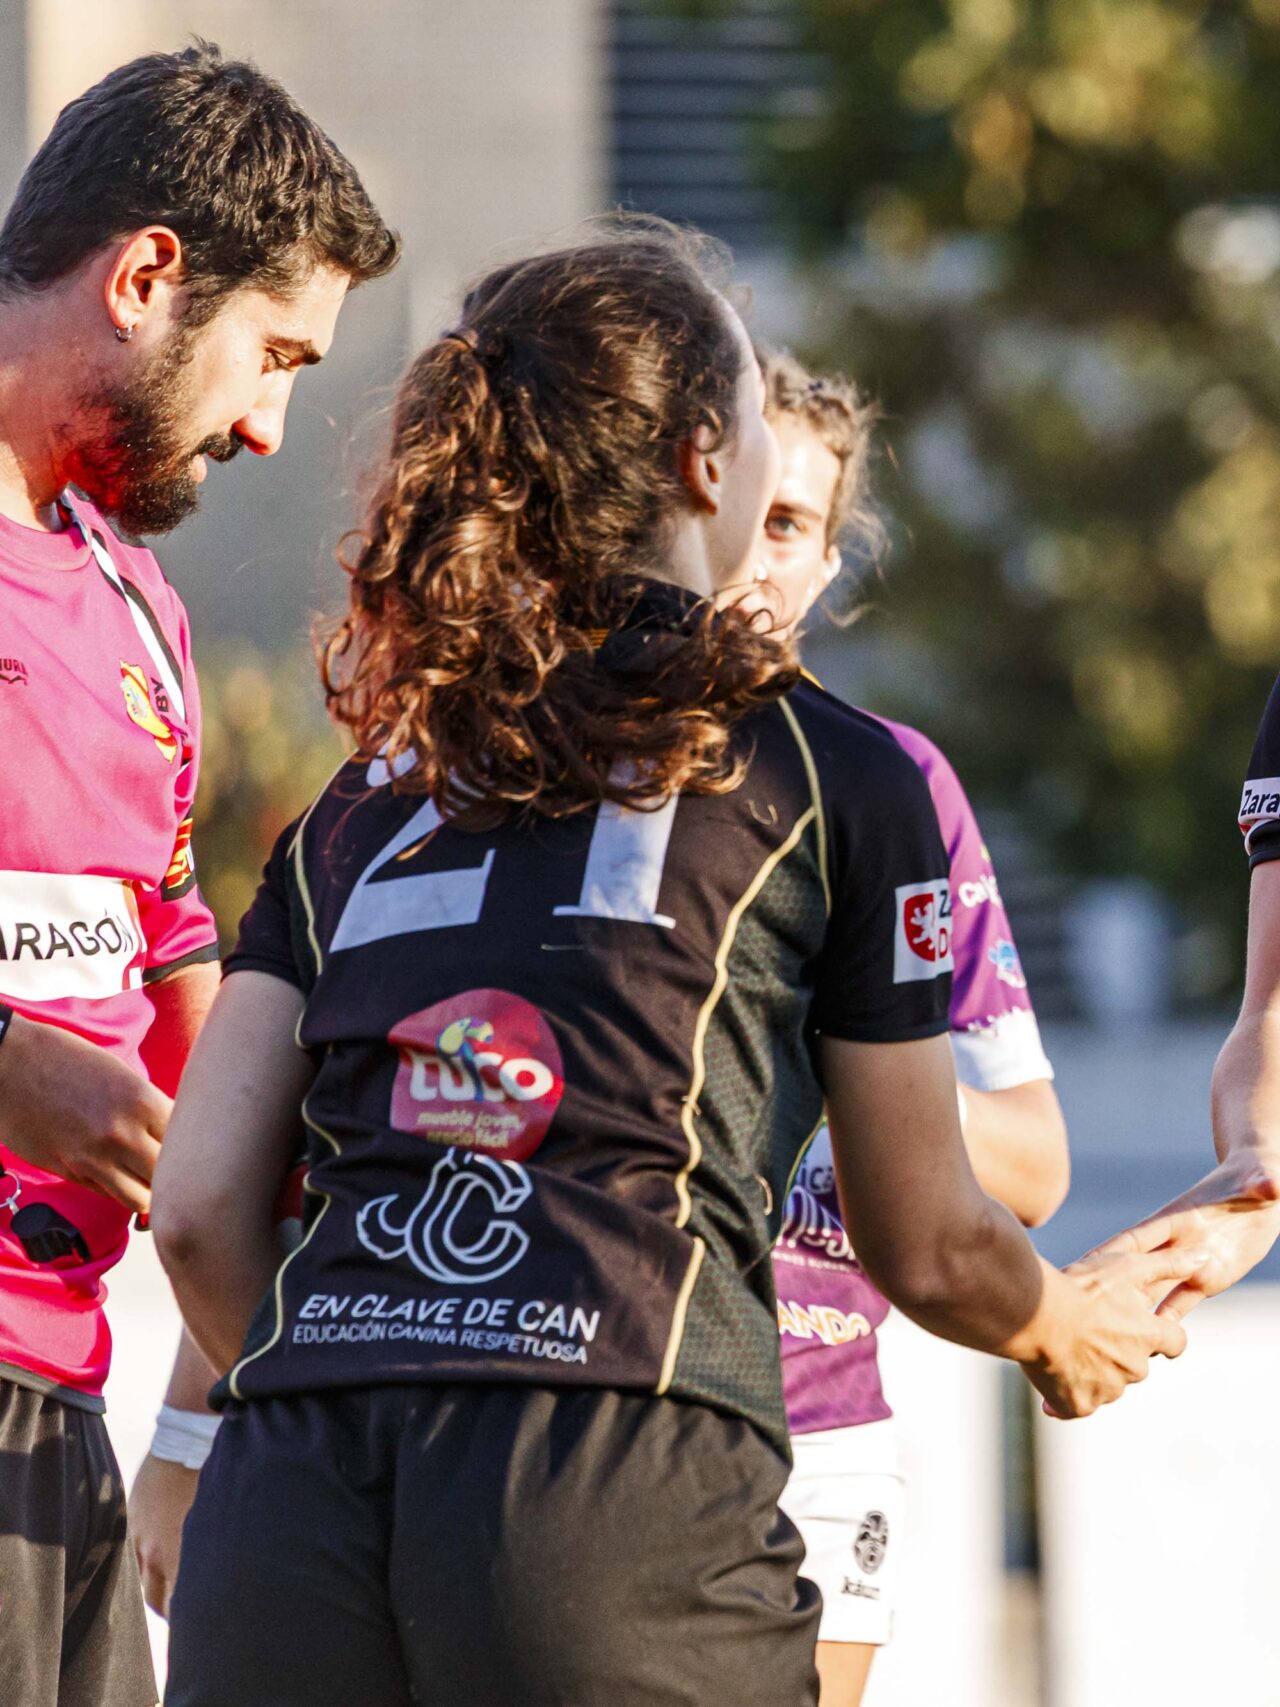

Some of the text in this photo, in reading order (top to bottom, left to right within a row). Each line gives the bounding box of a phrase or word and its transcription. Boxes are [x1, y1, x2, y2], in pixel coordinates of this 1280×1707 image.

[0, 907, 134, 961] RAGÓN
[293, 1318, 588, 1366] EDUCACIÓN CANINA RESPETUOSA
[299, 1293, 600, 1342] EN CLAVE DE CAN
